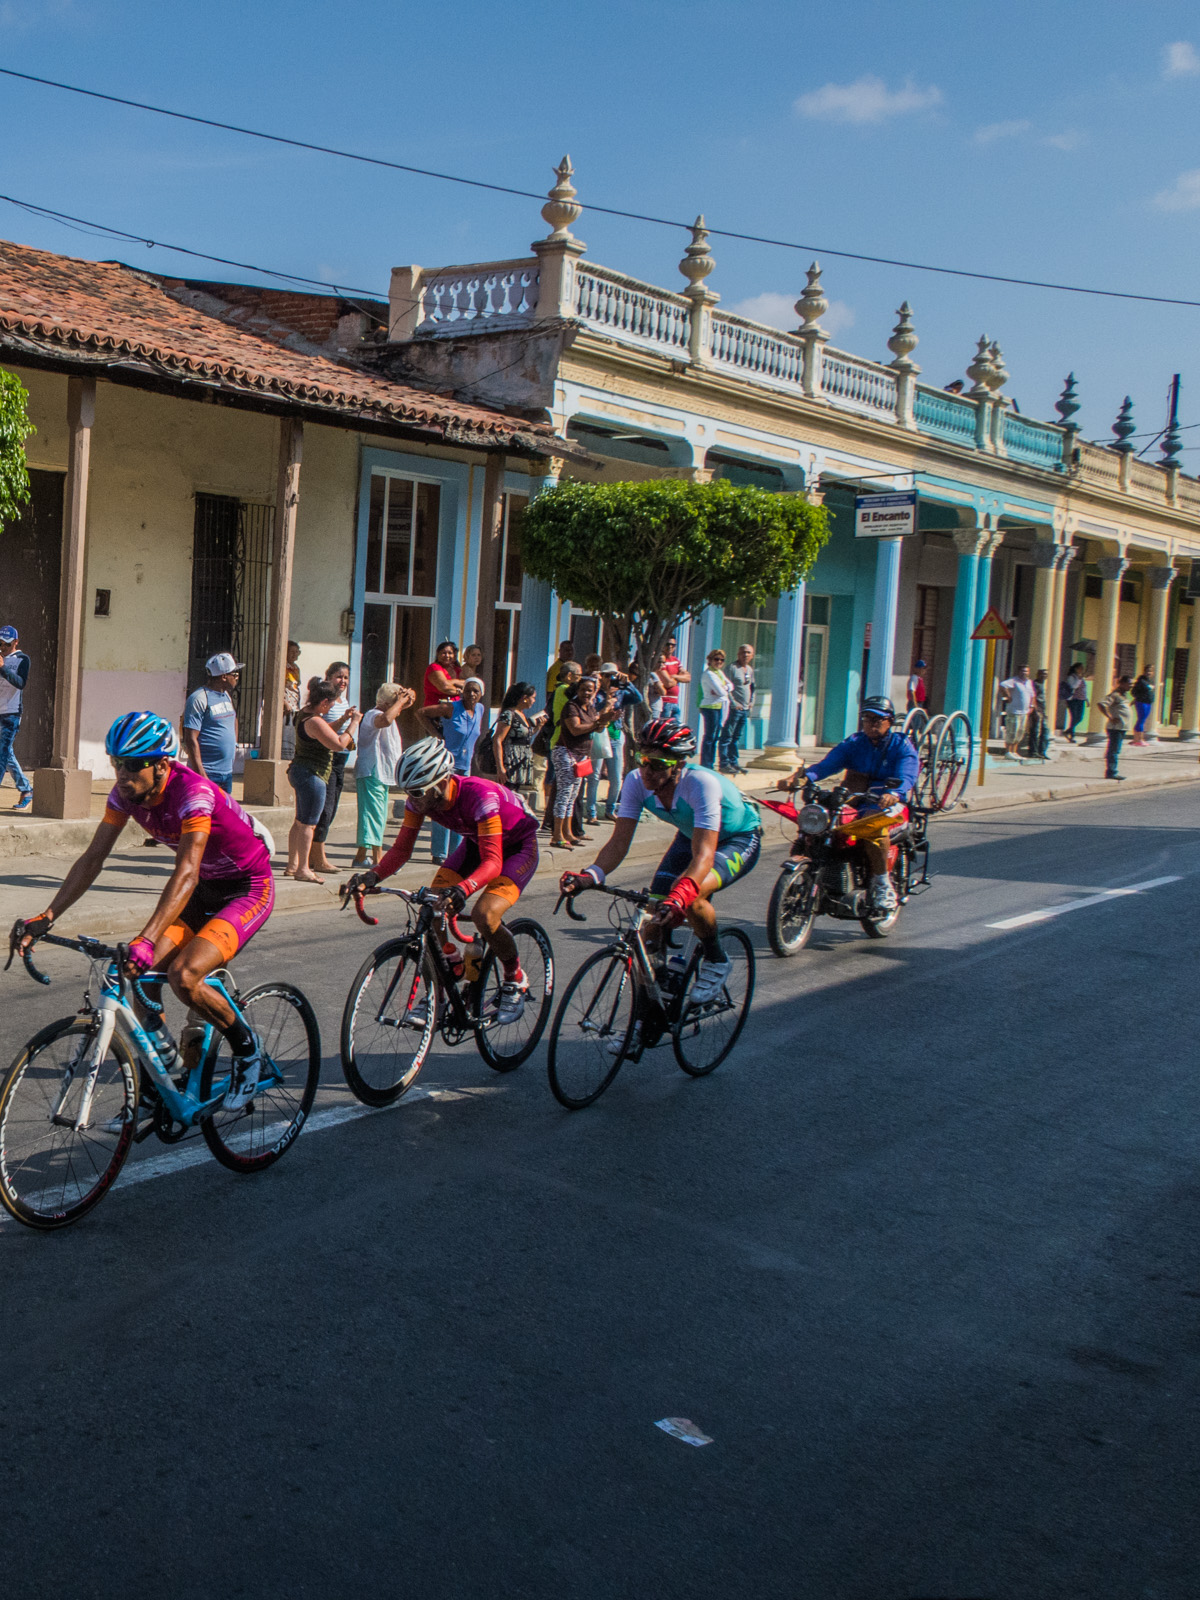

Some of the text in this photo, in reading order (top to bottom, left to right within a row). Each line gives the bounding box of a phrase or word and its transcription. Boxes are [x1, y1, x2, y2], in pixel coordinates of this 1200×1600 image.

[861, 511, 910, 522] El Encanto
[122, 1062, 135, 1122] BORA
[271, 1109, 305, 1154] BORA
